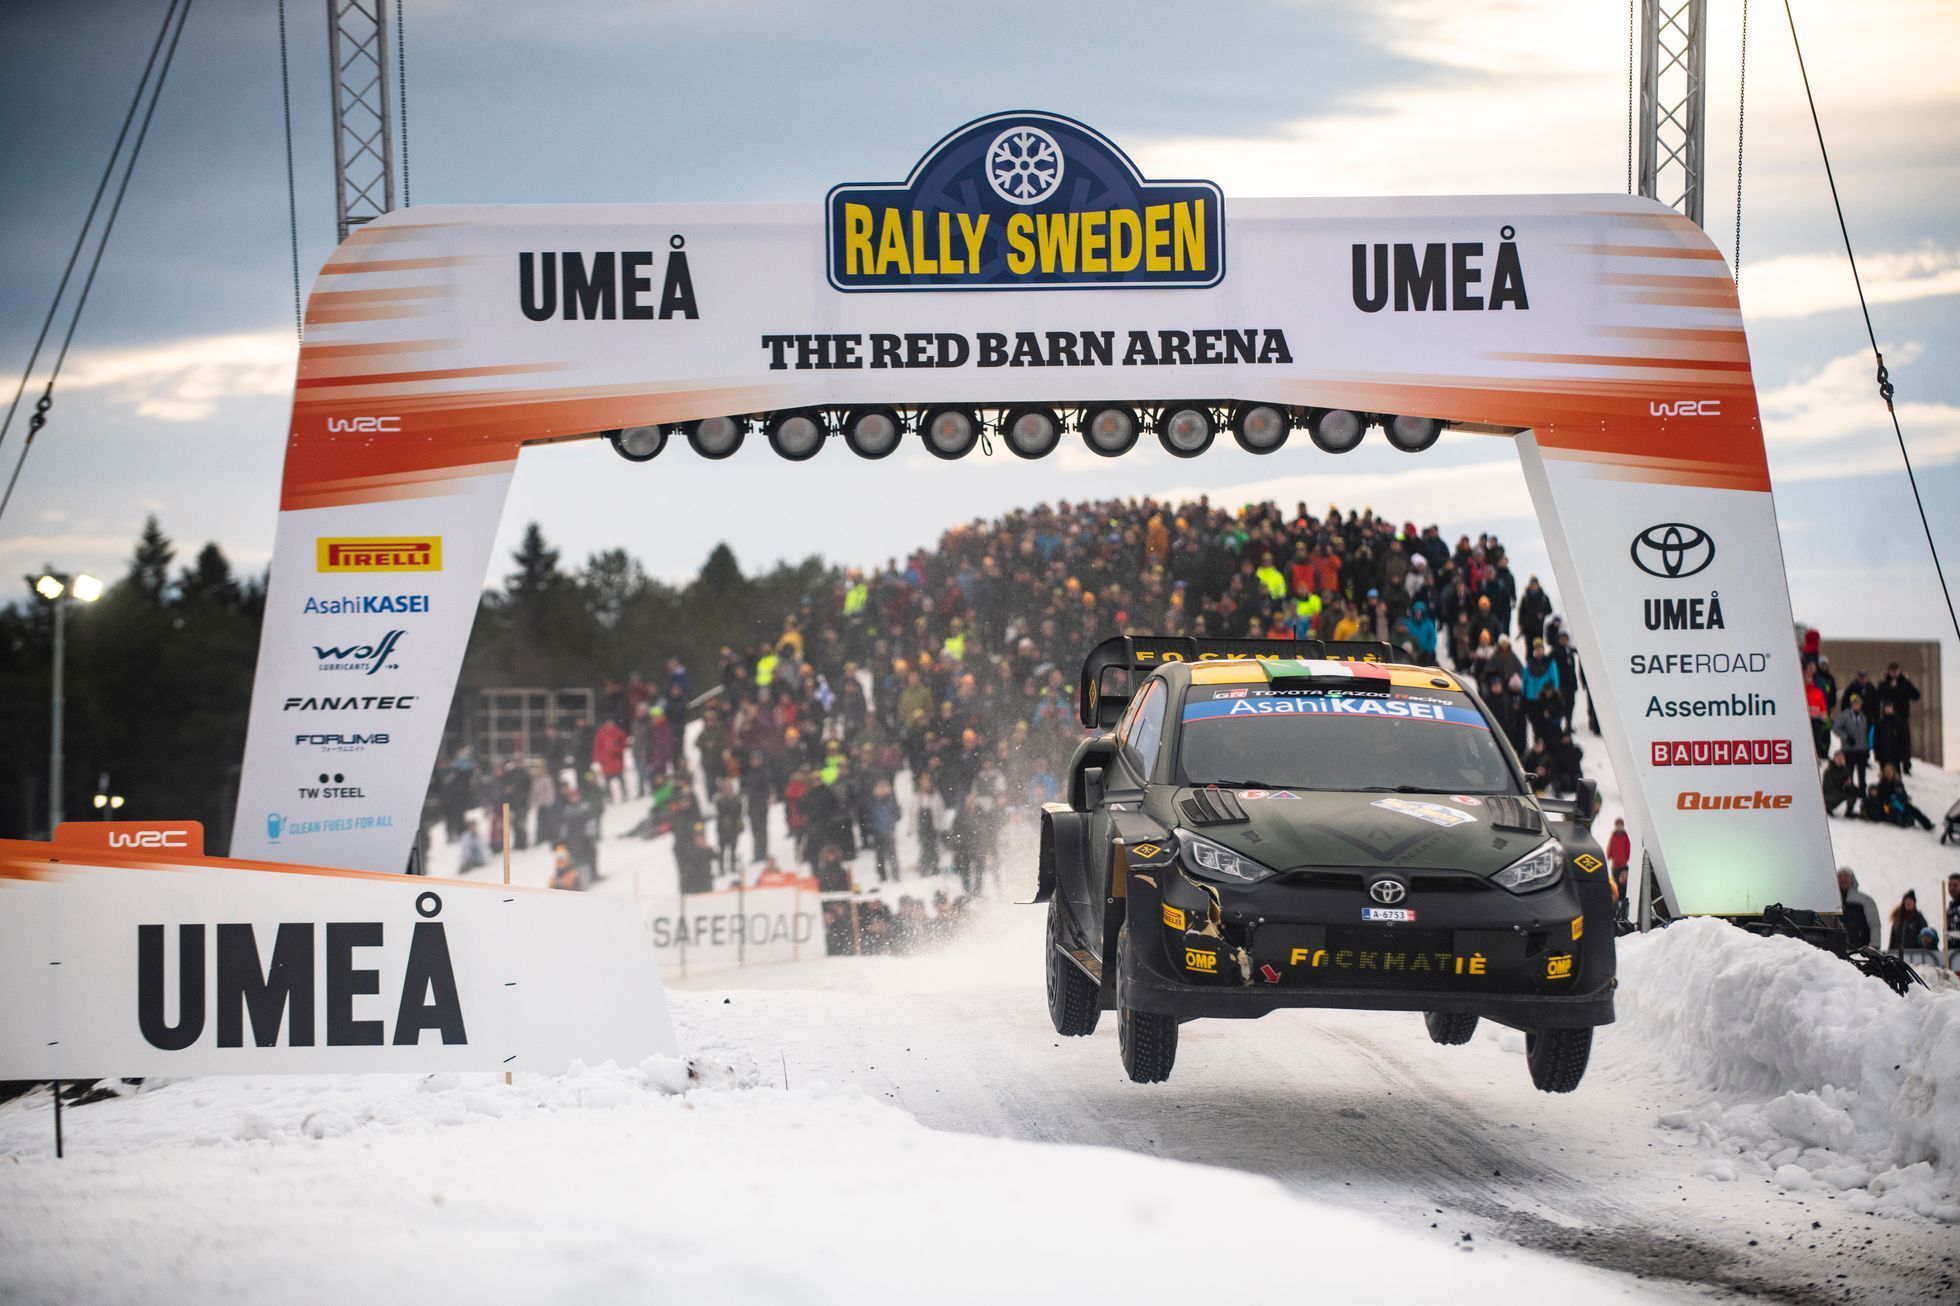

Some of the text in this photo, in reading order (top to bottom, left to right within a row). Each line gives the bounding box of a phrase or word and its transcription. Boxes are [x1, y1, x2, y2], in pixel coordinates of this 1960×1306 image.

[845, 199, 1206, 275] RALLY SWEDEN
[519, 234, 699, 321] UMEÅ
[1352, 225, 1529, 313] UMEÅ
[762, 329, 1293, 370] THE RED BARN ARENA
[1650, 400, 1721, 417] WRC
[328, 416, 401, 433] WRC
[328, 543, 431, 566] PIRELLI
[1644, 591, 1725, 631] UMEÅ
[319, 663, 370, 671] LUBRICANTS
[283, 696, 415, 711] FANATEC
[1215, 691, 1246, 699] GR
[1645, 693, 1776, 718] Assemblin
[295, 733, 390, 746] FORUM8
[1654, 740, 1789, 763] BAUHAUS
[298, 787, 366, 799] TW STEEL
[1676, 791, 1793, 810] Quicke
[289, 815, 393, 835] CLEAN FUELS FOR ALL
[109, 830, 188, 848] WRC
[1373, 911, 1405, 919] A-6753
[1185, 952, 1217, 970] OMP
[138, 892, 468, 1051] UMEÅ
